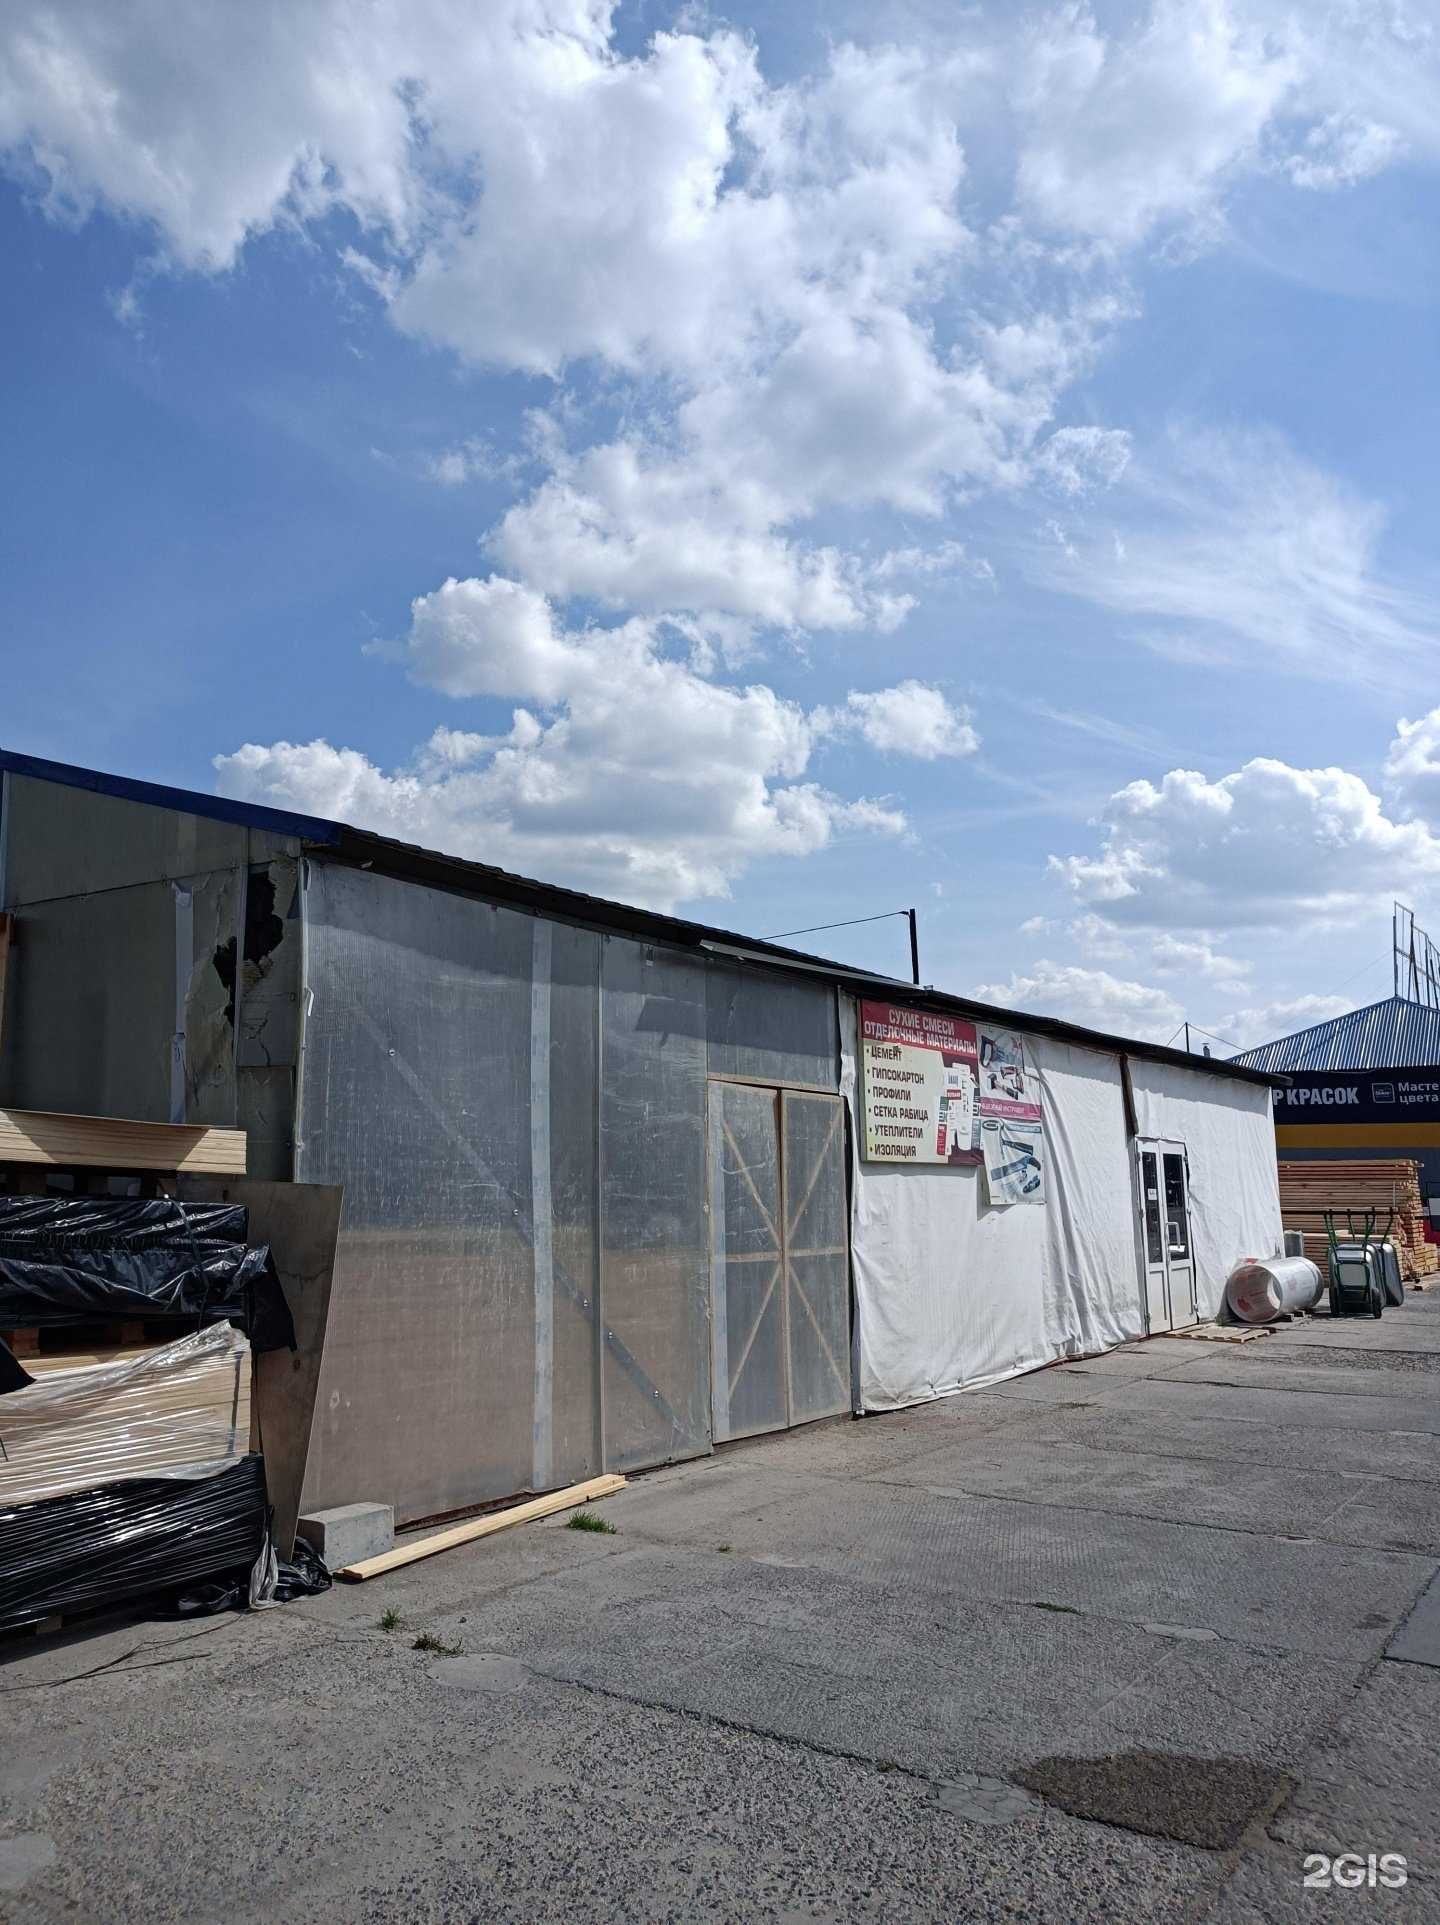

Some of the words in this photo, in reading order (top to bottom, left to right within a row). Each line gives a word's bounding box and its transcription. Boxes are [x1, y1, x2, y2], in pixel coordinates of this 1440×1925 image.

[888, 1009, 920, 1029] СУХИЕ
[922, 1016, 955, 1036] СМЕСИ
[864, 1020, 925, 1045] ОТДЕЛОЧНЫЕ
[926, 1033, 977, 1055] МАТЕРИАЛЫ
[871, 1046, 902, 1061] ЦЕМЕНТ
[872, 1067, 925, 1084] ГИПСОКАРТОН
[872, 1086, 912, 1101] ПРОФИЛИ
[1286, 1087, 1360, 1105] КРАСОК
[1399, 1094, 1439, 1105] цвета
[873, 1105, 898, 1119] СЕТКА
[899, 1108, 929, 1123] РАБИЦА
[874, 1124, 924, 1139] УТЕПЛИТЕЛИ
[874, 1143, 917, 1159] ИЗОЛЯЦИЯ
